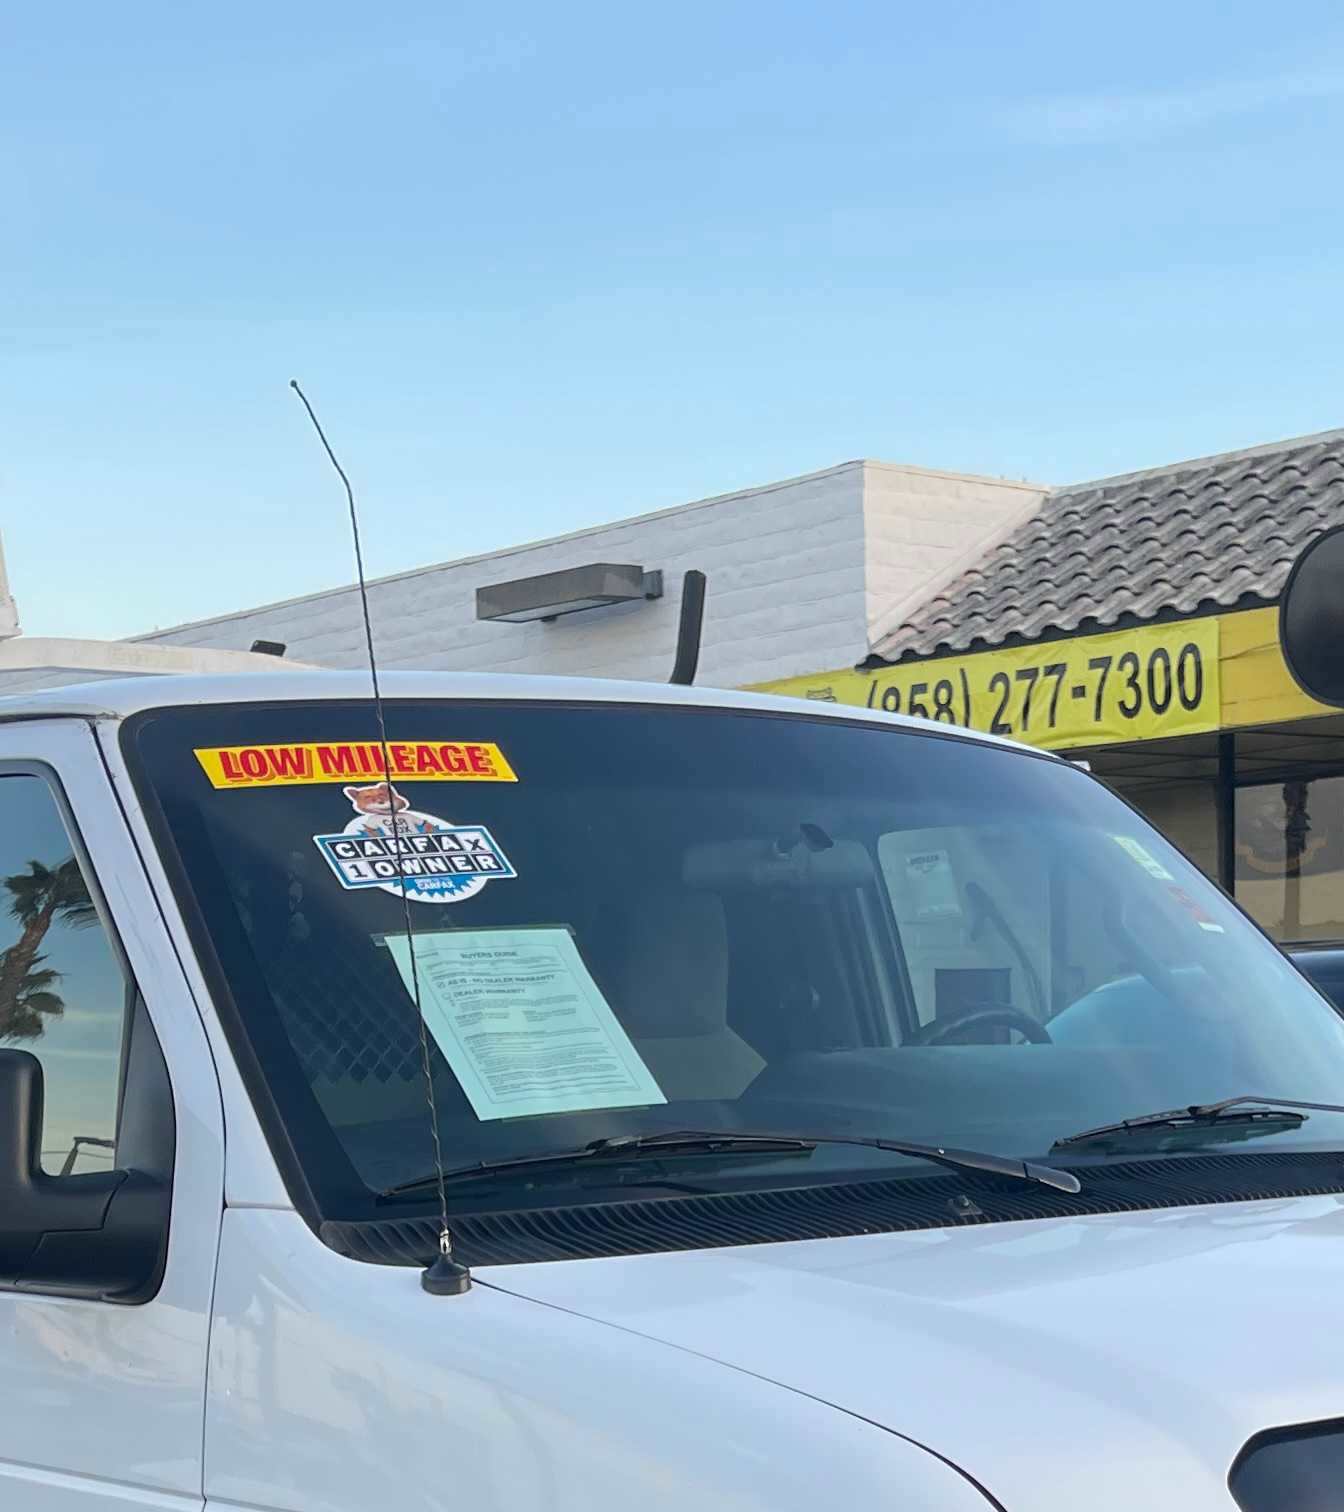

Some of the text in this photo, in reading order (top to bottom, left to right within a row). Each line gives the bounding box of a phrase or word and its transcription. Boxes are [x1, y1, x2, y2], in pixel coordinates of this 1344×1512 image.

[989, 642, 1203, 736] 277-7300
[218, 744, 496, 781] LOW MILEAGE
[334, 833, 487, 859] CARFAX
[349, 853, 499, 878] 1 OWNER
